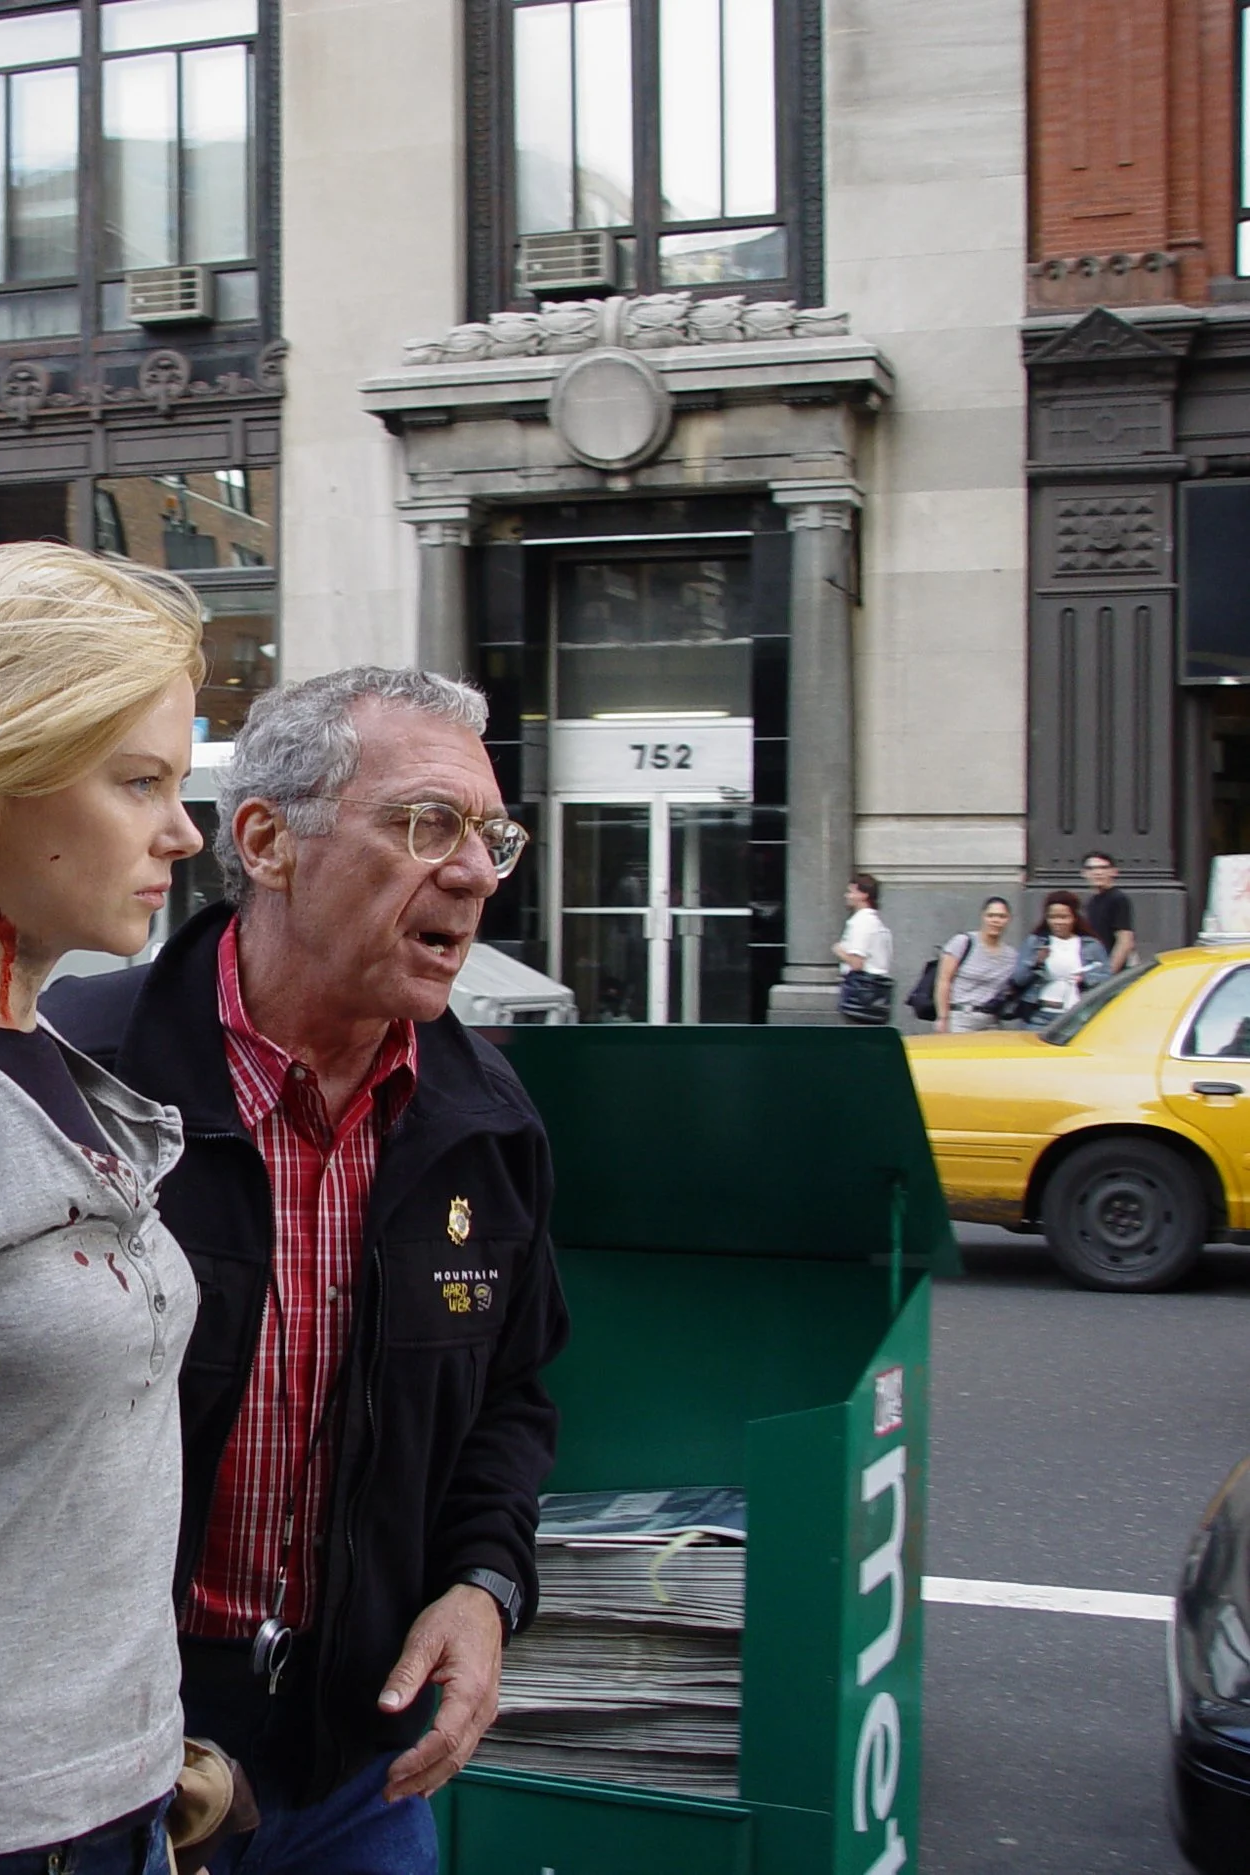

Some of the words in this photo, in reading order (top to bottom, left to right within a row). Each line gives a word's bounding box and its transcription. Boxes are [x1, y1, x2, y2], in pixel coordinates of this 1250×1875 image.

[629, 743, 693, 770] 752
[433, 1269, 499, 1282] MOUNTAIN
[442, 1282, 468, 1299] HARD
